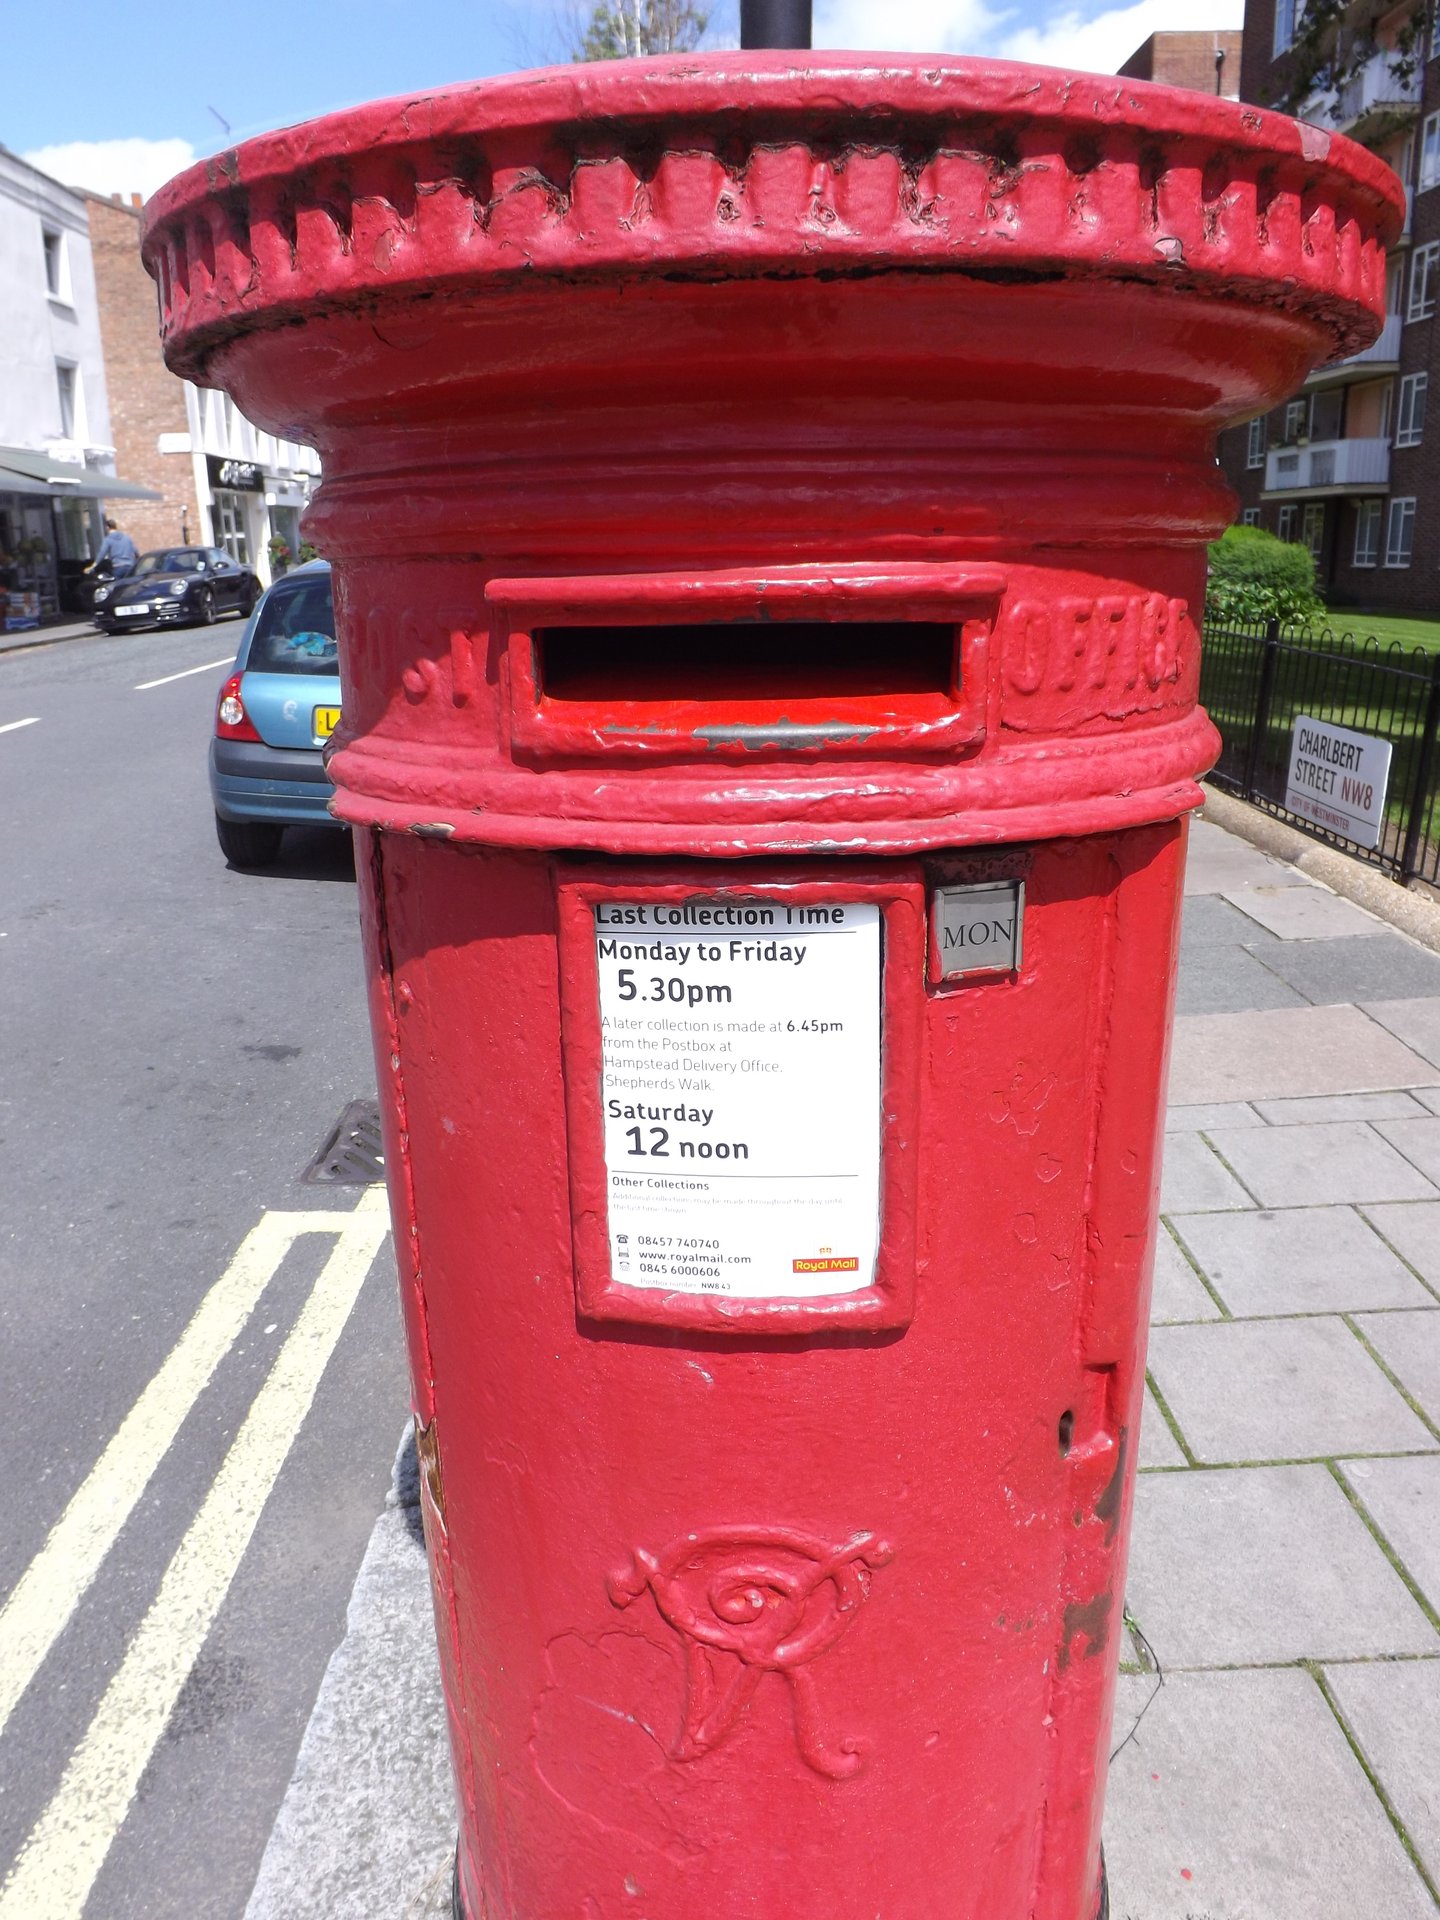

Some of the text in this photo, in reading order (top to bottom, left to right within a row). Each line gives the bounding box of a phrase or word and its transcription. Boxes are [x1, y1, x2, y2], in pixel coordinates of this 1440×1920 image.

[1003, 592, 1190, 696] OFFICE
[1298, 728, 1364, 772] CHARLBERT
[1295, 758, 1374, 811] STREET NW8
[1311, 803, 1350, 830] WESTMINSTER
[597, 904, 647, 925] Last
[653, 905, 774, 926] Collection
[943, 918, 1014, 950] MON
[599, 939, 807, 966] Monday to Friday
[618, 969, 732, 1008] 5.30pm
[602, 1016, 843, 1034] A later collection is made at 6.45pm
[603, 1035, 733, 1052] from the Postbox at
[604, 1055, 783, 1074] Hampstead Delivery Office.
[605, 1074, 676, 1090] Shepherds
[608, 1099, 714, 1127] Saturday
[625, 1126, 749, 1159] 12 noon
[612, 1176, 710, 1191] Other Collections
[638, 1235, 720, 1249] 08457 740740
[639, 1251, 751, 1264] www.royalmail.com
[796, 1258, 856, 1272] Royal Mail
[640, 1263, 720, 1277] 0845 6000606
